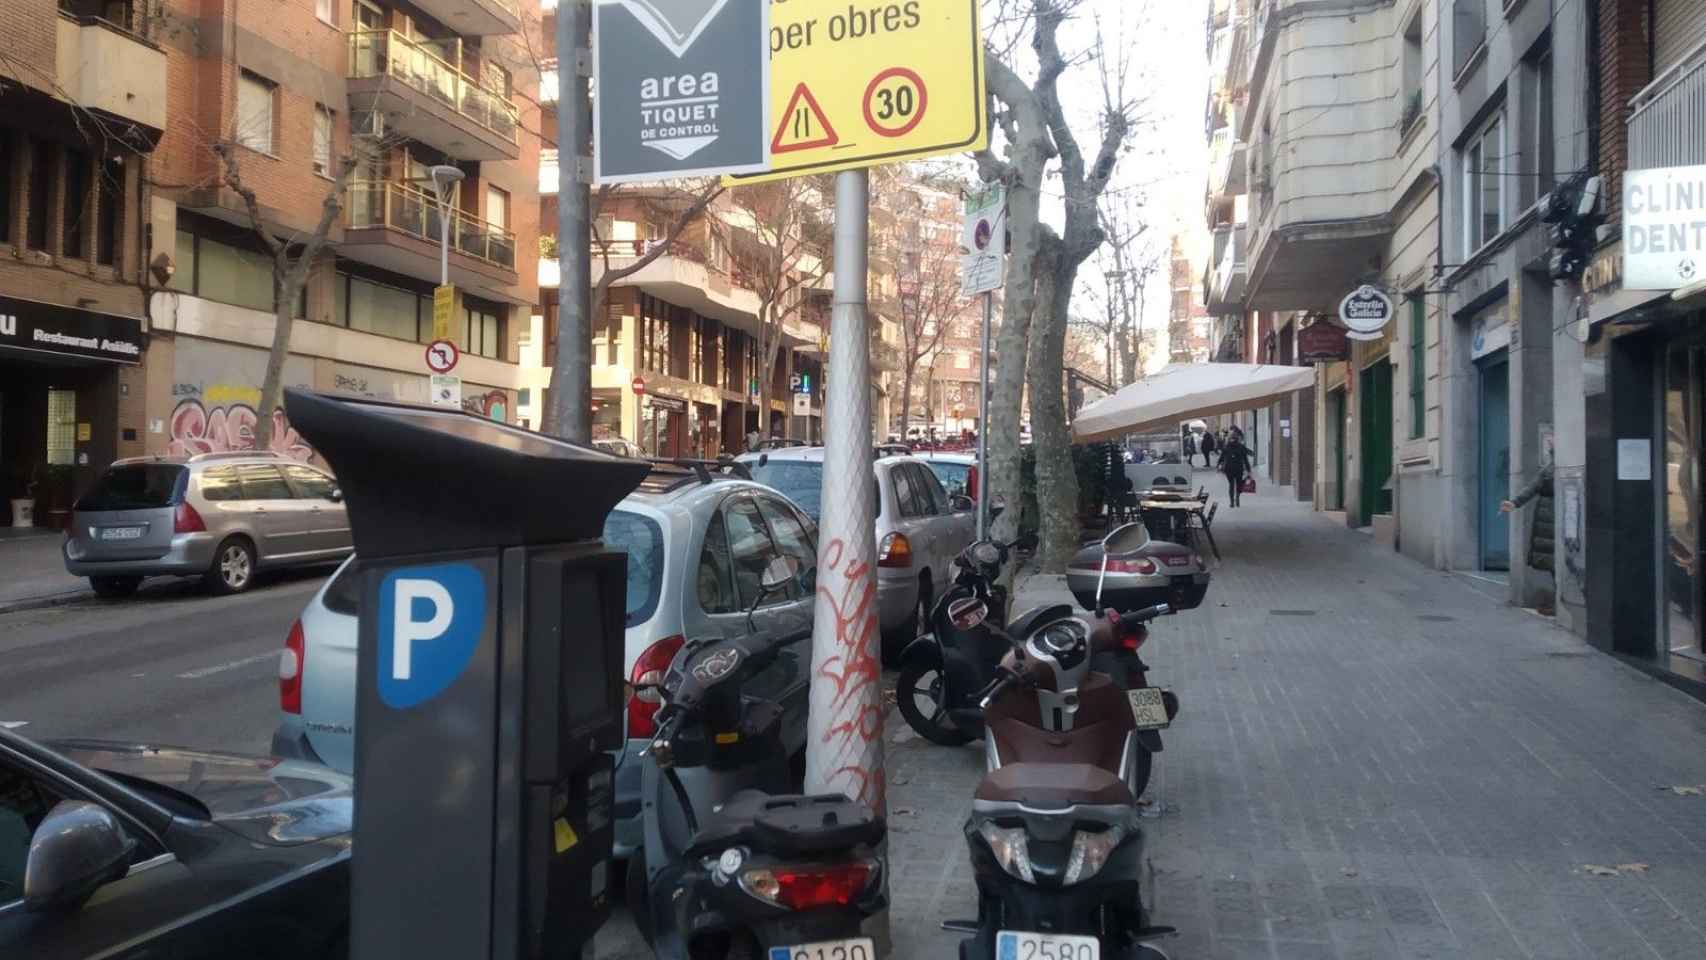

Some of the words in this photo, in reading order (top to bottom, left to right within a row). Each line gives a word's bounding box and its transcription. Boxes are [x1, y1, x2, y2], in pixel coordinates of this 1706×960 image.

[769, 20, 817, 60] per
[828, 1, 921, 41] obres
[641, 72, 719, 99] area
[877, 85, 913, 120] 30
[641, 104, 719, 125] TIQUET
[641, 129, 656, 139] DE
[659, 124, 719, 138] CONTROL
[1628, 222, 1706, 254] DENT
[1347, 299, 1384, 309] Estrella
[1349, 308, 1382, 318] Galicia
[33, 328, 98, 349] Restaurant
[393, 578, 454, 680] P
[1022, 940, 1093, 960] 2580
